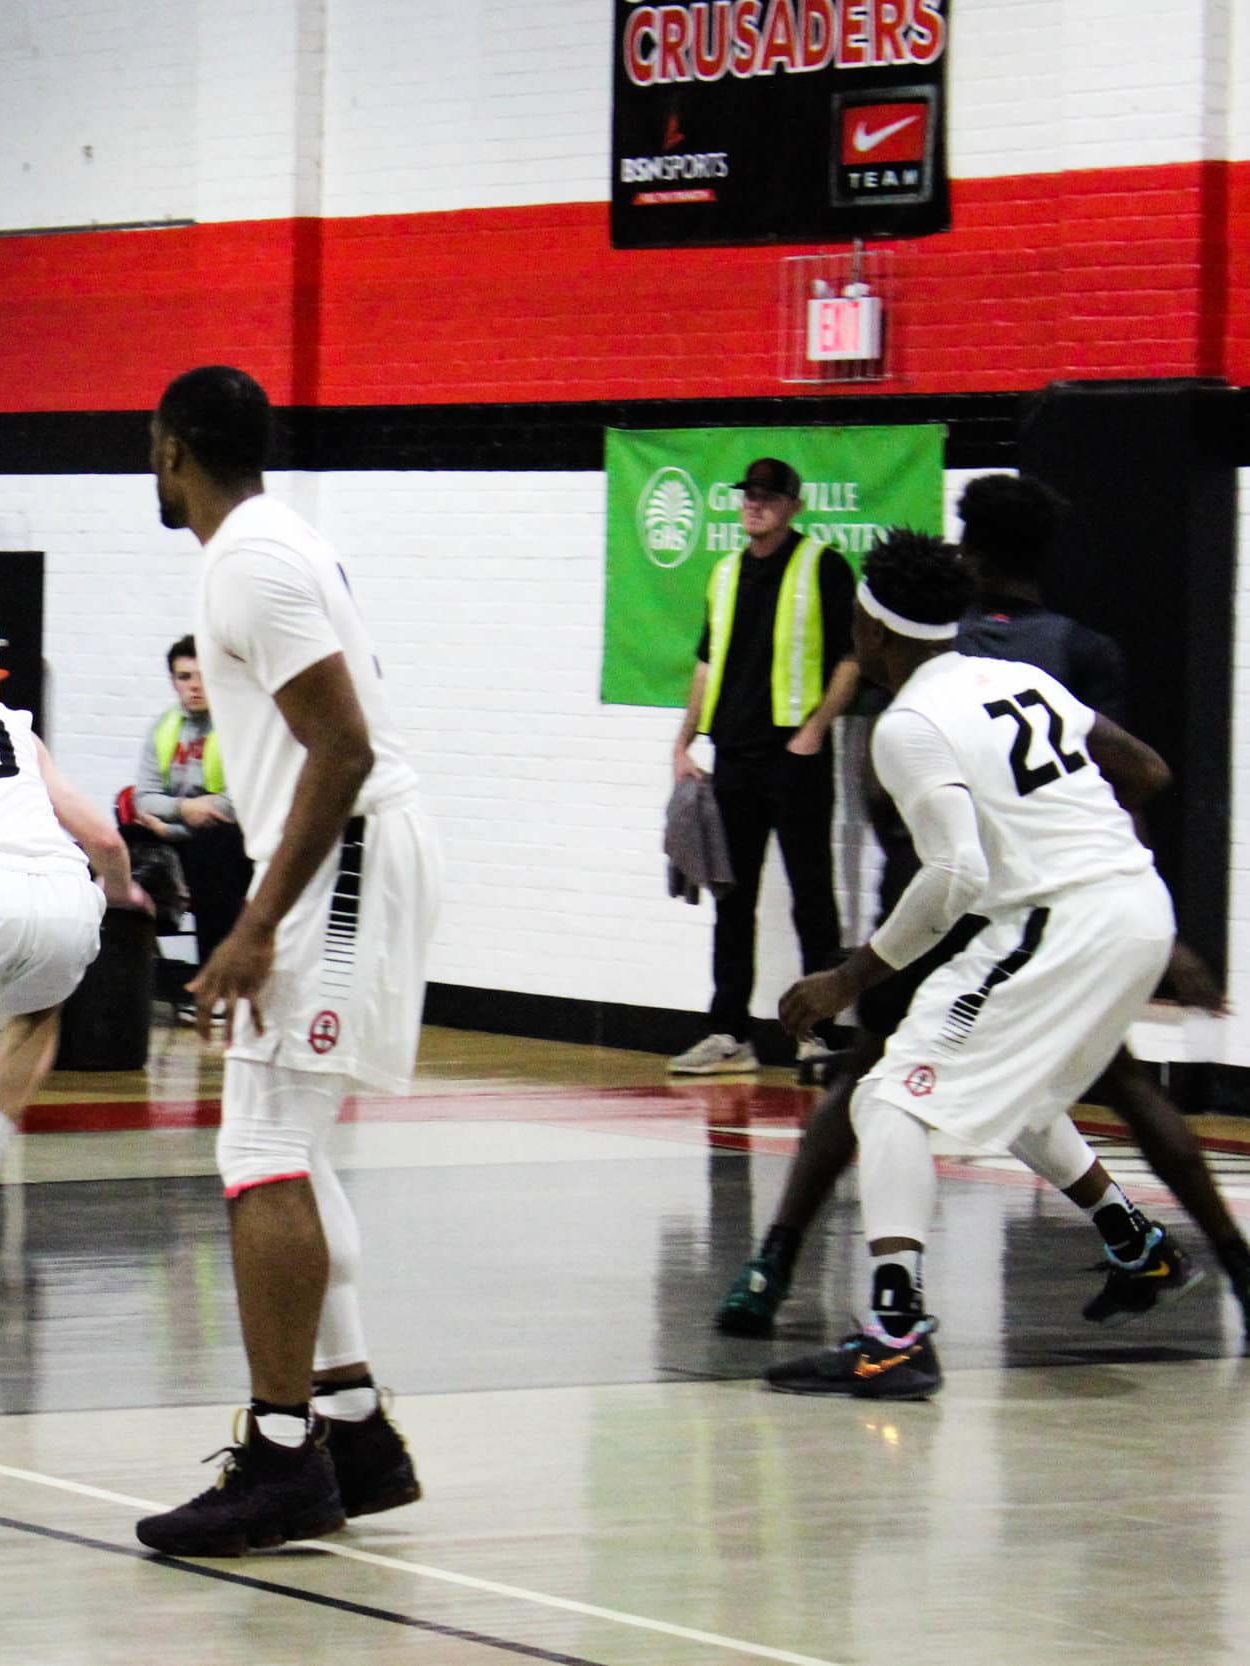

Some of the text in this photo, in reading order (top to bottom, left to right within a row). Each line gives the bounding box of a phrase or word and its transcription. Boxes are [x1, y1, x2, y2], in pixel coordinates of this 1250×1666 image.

[623, 0, 947, 86] CRUSADERS
[848, 169, 919, 189] TEAM
[707, 482, 861, 512] GRILLE
[982, 688, 1088, 797] 22
